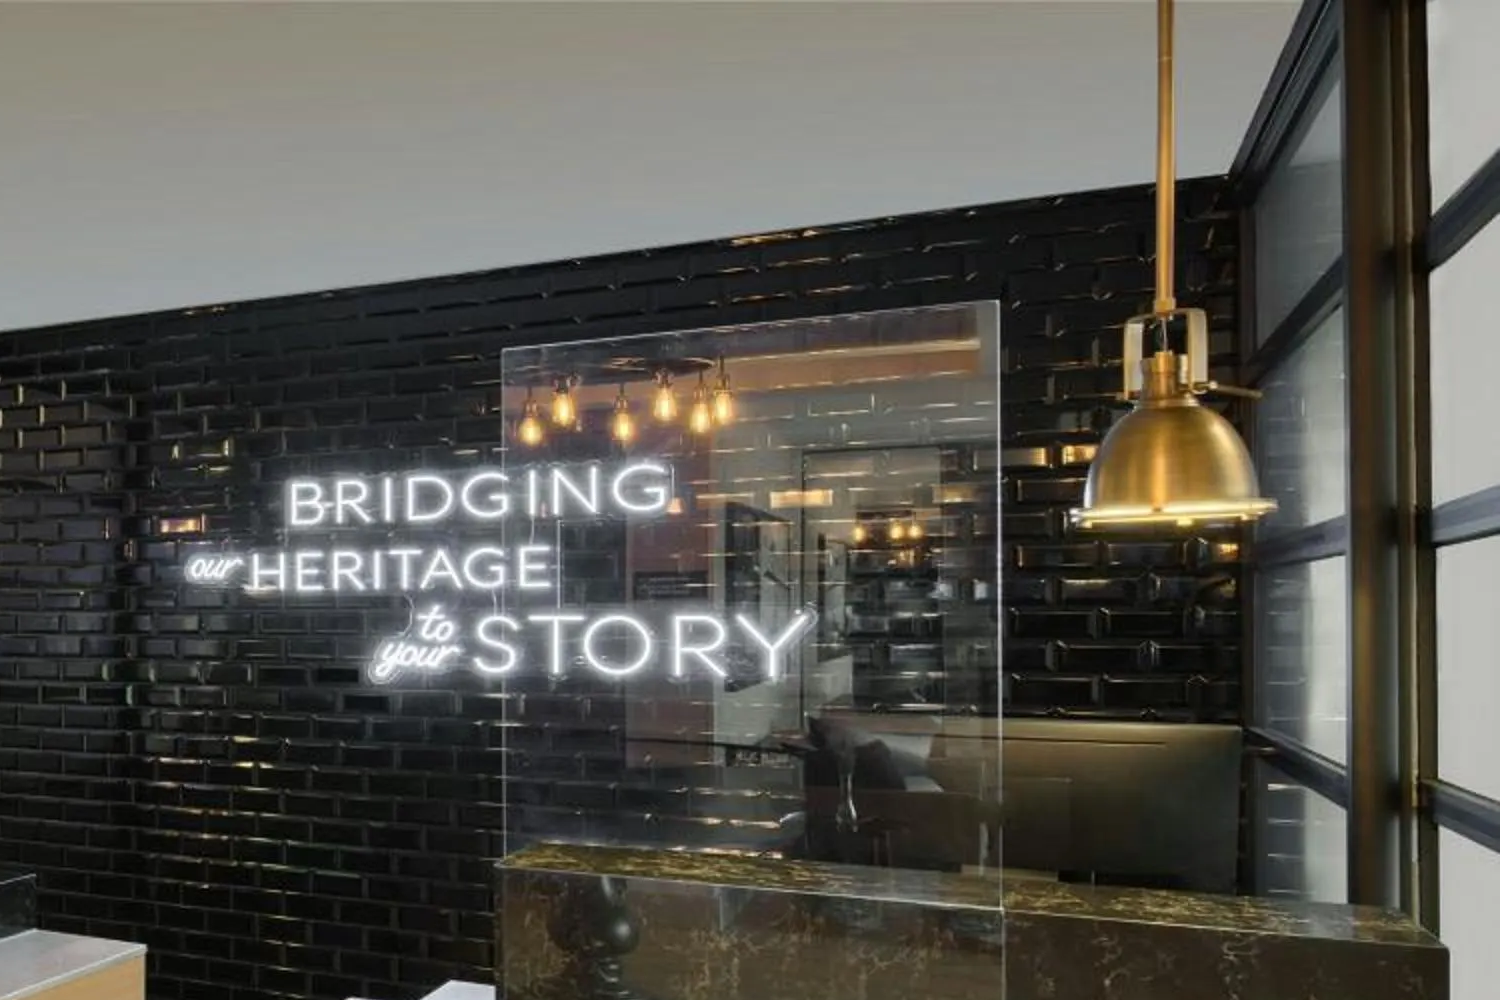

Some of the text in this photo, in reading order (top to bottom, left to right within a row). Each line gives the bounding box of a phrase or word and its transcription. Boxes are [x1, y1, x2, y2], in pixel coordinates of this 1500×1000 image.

[289, 462, 669, 526] BRIDGING
[188, 546, 553, 591] our HERITAGE
[373, 613, 810, 679] your STORY
[416, 604, 456, 643] to
